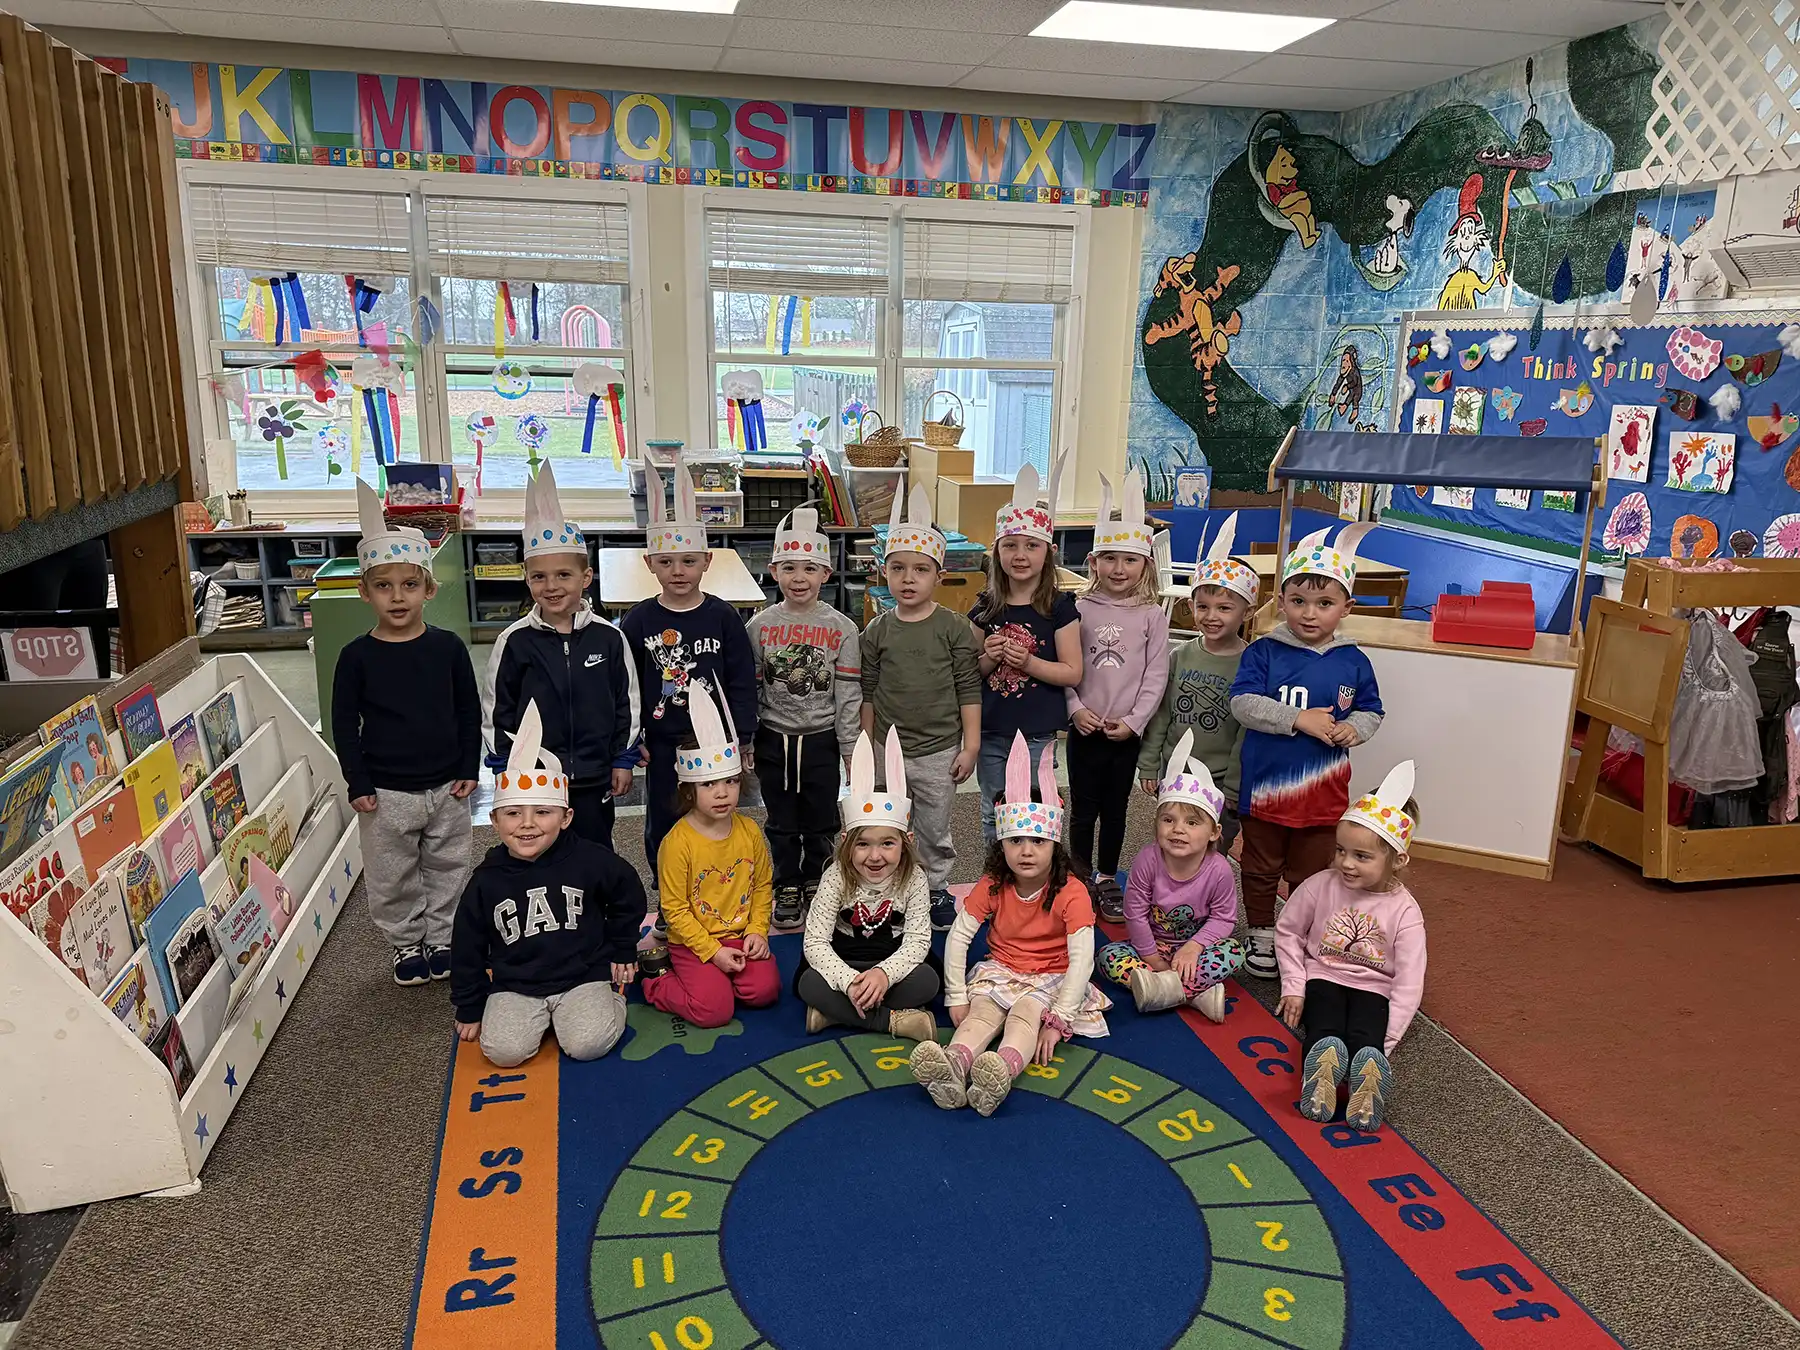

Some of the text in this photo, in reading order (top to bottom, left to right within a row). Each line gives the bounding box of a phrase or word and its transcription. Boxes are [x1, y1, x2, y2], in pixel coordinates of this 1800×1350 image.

[172, 62, 1156, 189] J K L M N O P Q R S T U V W X Y Z
[1521, 356, 1578, 380] Think
[1591, 356, 1669, 388] Spring
[694, 638, 721, 655] GAP
[760, 624, 842, 651] CRUSHING
[587, 654, 602, 662] NIKE
[1179, 668, 1230, 693] MONSTE
[1279, 685, 1309, 710] 10
[64, 730, 79, 745] oup
[241, 826, 267, 839] SPRING!
[80, 882, 109, 916] I Love Mud
[93, 902, 104, 918] and
[83, 926, 95, 943] Mud
[94, 915, 108, 931] Loves
[108, 903, 118, 918] Me
[494, 885, 584, 946] GAP
[64, 944, 77, 957] The
[795, 1059, 843, 1088] 15
[870, 1045, 910, 1071] 16
[727, 1089, 779, 1120] 14
[1092, 1074, 1142, 1105] 19
[1158, 1109, 1215, 1142] 20
[673, 1132, 726, 1164] 13
[1227, 1162, 1253, 1189] 1
[1238, 1035, 1294, 1076] Cc
[1368, 1172, 1446, 1232] Ee
[1456, 1262, 1560, 1324] Ff
[444, 1072, 528, 1314] Rr Ss Tt
[639, 1189, 692, 1220] 12
[1255, 1221, 1290, 1252] 2
[632, 1252, 675, 1289] 11
[1263, 1287, 1296, 1321] 3
[648, 1315, 714, 1350] 10
